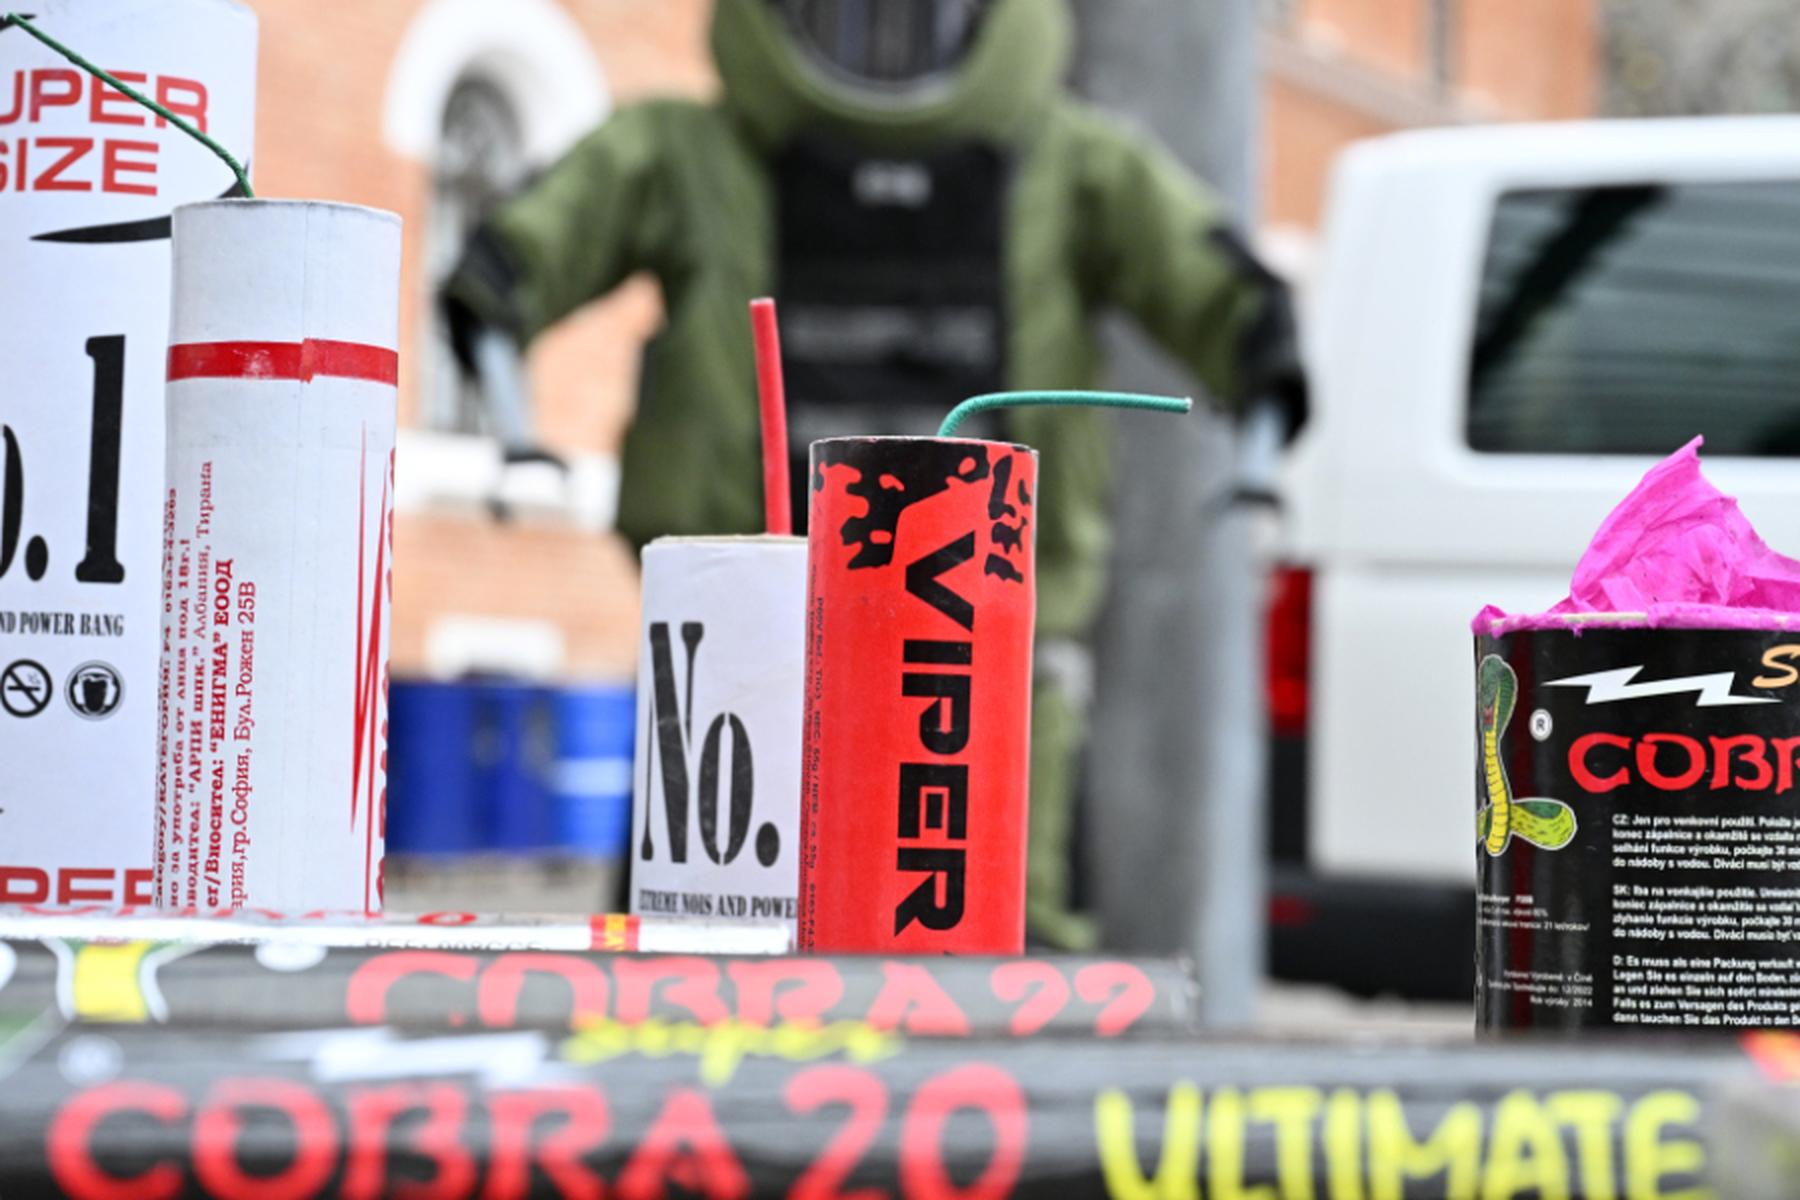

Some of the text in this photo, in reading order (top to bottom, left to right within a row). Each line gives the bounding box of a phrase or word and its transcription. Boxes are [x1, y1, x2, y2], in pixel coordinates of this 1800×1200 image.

[0, 137, 159, 196] IZE
[197, 460, 214, 538] Тирана
[214, 559, 233, 627] ЕООД
[20, 611, 75, 635] POWER
[80, 613, 125, 637] BANG
[175, 707, 185, 733] от
[641, 621, 780, 868] No.
[895, 530, 975, 938] VIPER
[172, 740, 185, 844] употреба
[1653, 816, 1671, 827] pro
[1612, 857, 1626, 867] do
[718, 894, 747, 916] AND
[1612, 928, 1626, 938] do
[1613, 970, 1644, 982] Legen
[1646, 970, 1662, 981] Sie
[1736, 972, 1754, 982] den
[1626, 955, 1640, 966] Es
[1642, 957, 1669, 967] muss
[1713, 957, 1756, 971] Packung
[1627, 984, 1647, 995] und
[1704, 985, 1725, 997] sich
[1613, 997, 1637, 1008] Falls
[1639, 1000, 1651, 1009] es
[1653, 1000, 1676, 1009] zum
[1677, 999, 1725, 1012] Versagen
[1726, 1000, 1744, 1011] des
[1613, 1011, 1639, 1022] dann
[1640, 1013, 1682, 1024] tauchen
[1683, 1013, 1700, 1024] Sie
[1702, 1014, 1720, 1025] das
[1722, 1014, 1761, 1025] Produkt
[1774, 1015, 1790, 1025] den
[46, 1062, 1029, 1200] COBRA 20
[1095, 1080, 1712, 1200] ULTIMATE
